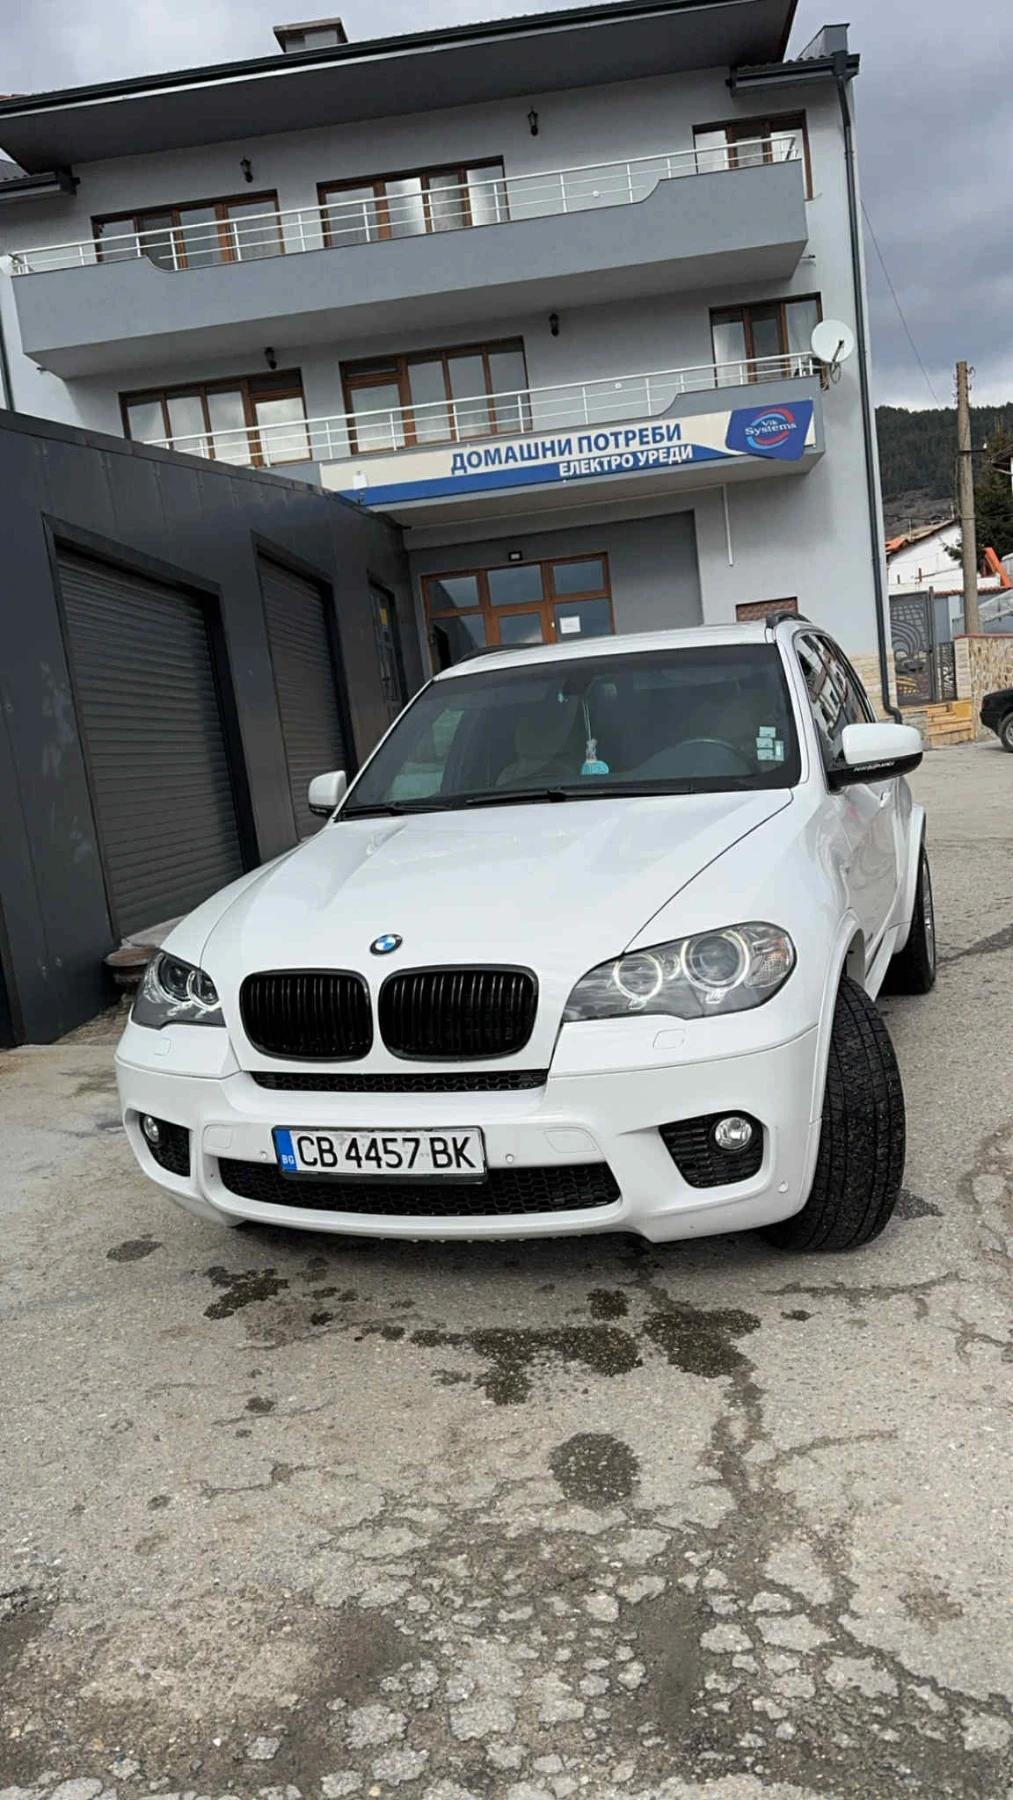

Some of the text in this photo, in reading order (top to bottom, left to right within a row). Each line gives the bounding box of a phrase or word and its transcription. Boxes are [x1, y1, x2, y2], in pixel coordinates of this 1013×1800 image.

[745, 423, 797, 436] Systems
[451, 423, 682, 475] ДОМАШНИ ПОТРЕБИ
[559, 444, 693, 477] ЕЛЕКТРО УРЕДИ
[282, 1155, 295, 1165] BG
[297, 1136, 476, 1169] CB 4457 BK
